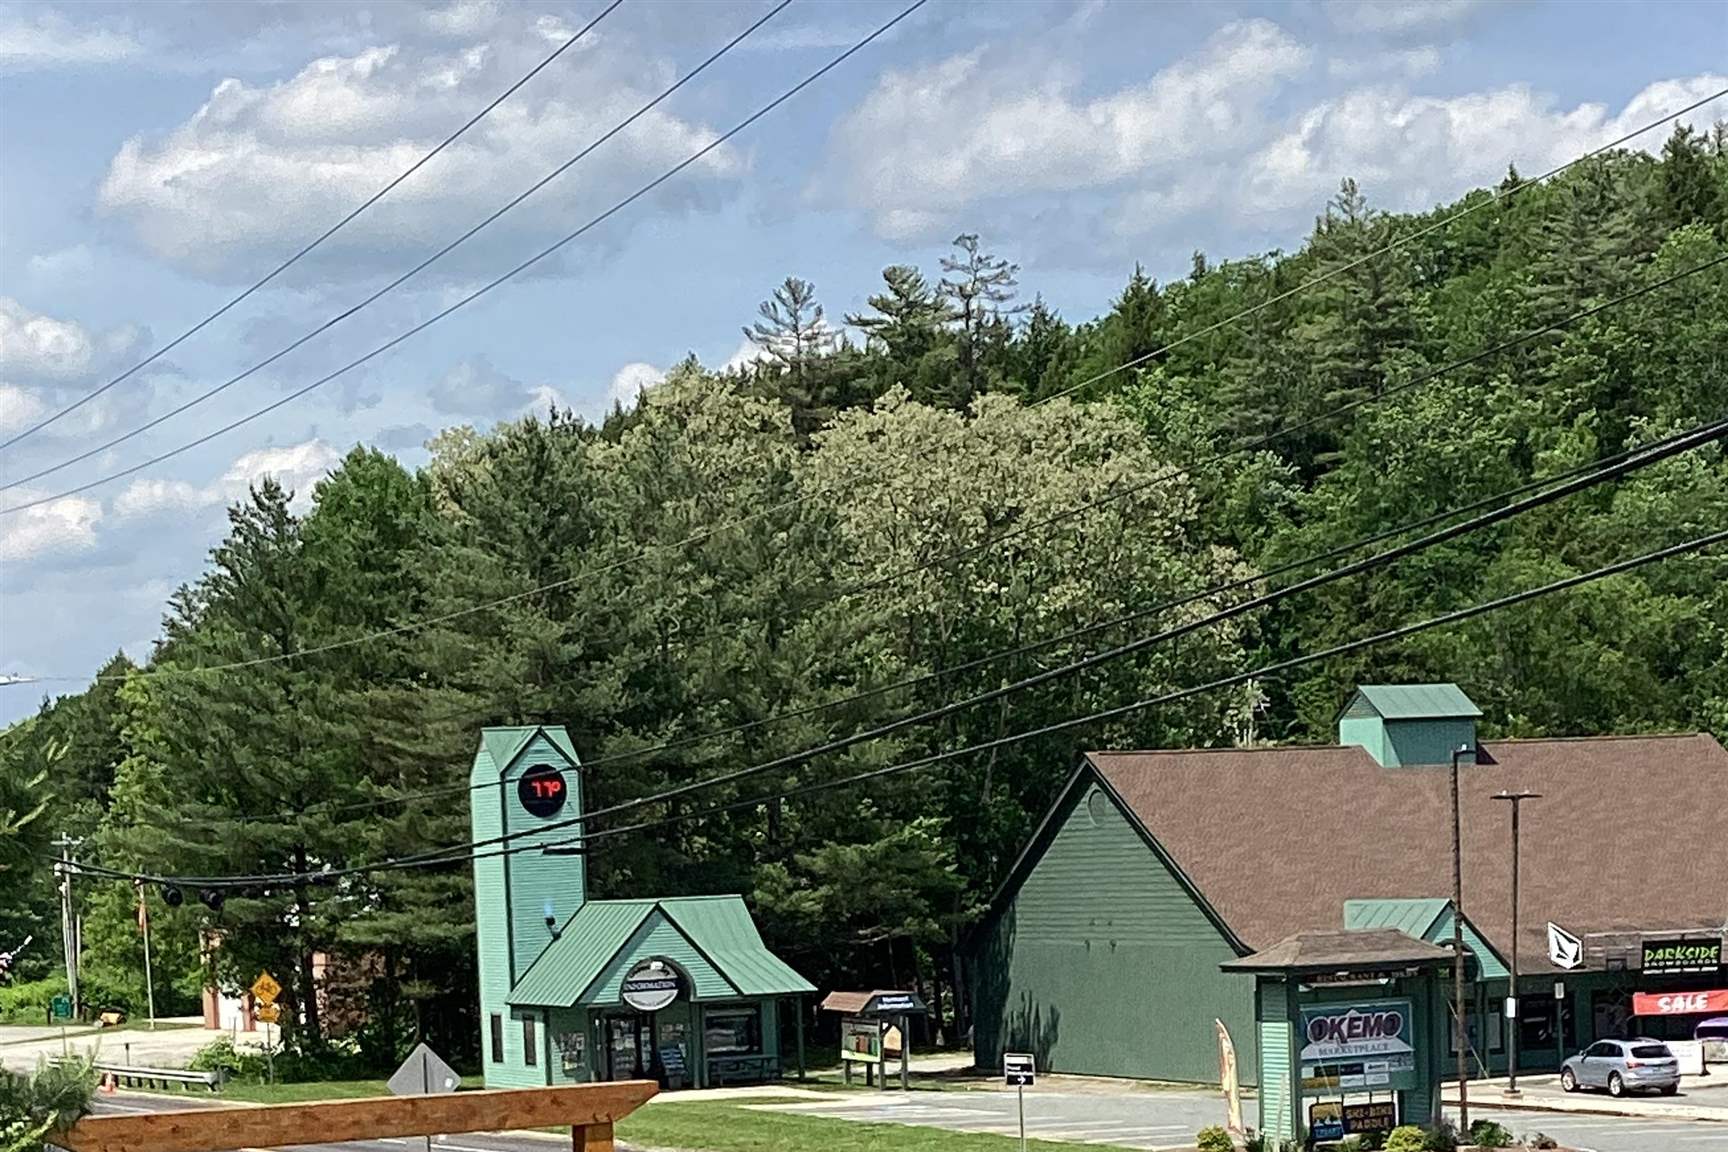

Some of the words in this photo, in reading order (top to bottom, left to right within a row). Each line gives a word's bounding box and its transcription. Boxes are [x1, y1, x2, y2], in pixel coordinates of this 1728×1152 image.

[1644, 945, 1720, 961] DARKSIDE
[1657, 994, 1709, 1012] SALE
[1308, 1011, 1404, 1044] OKEMO
